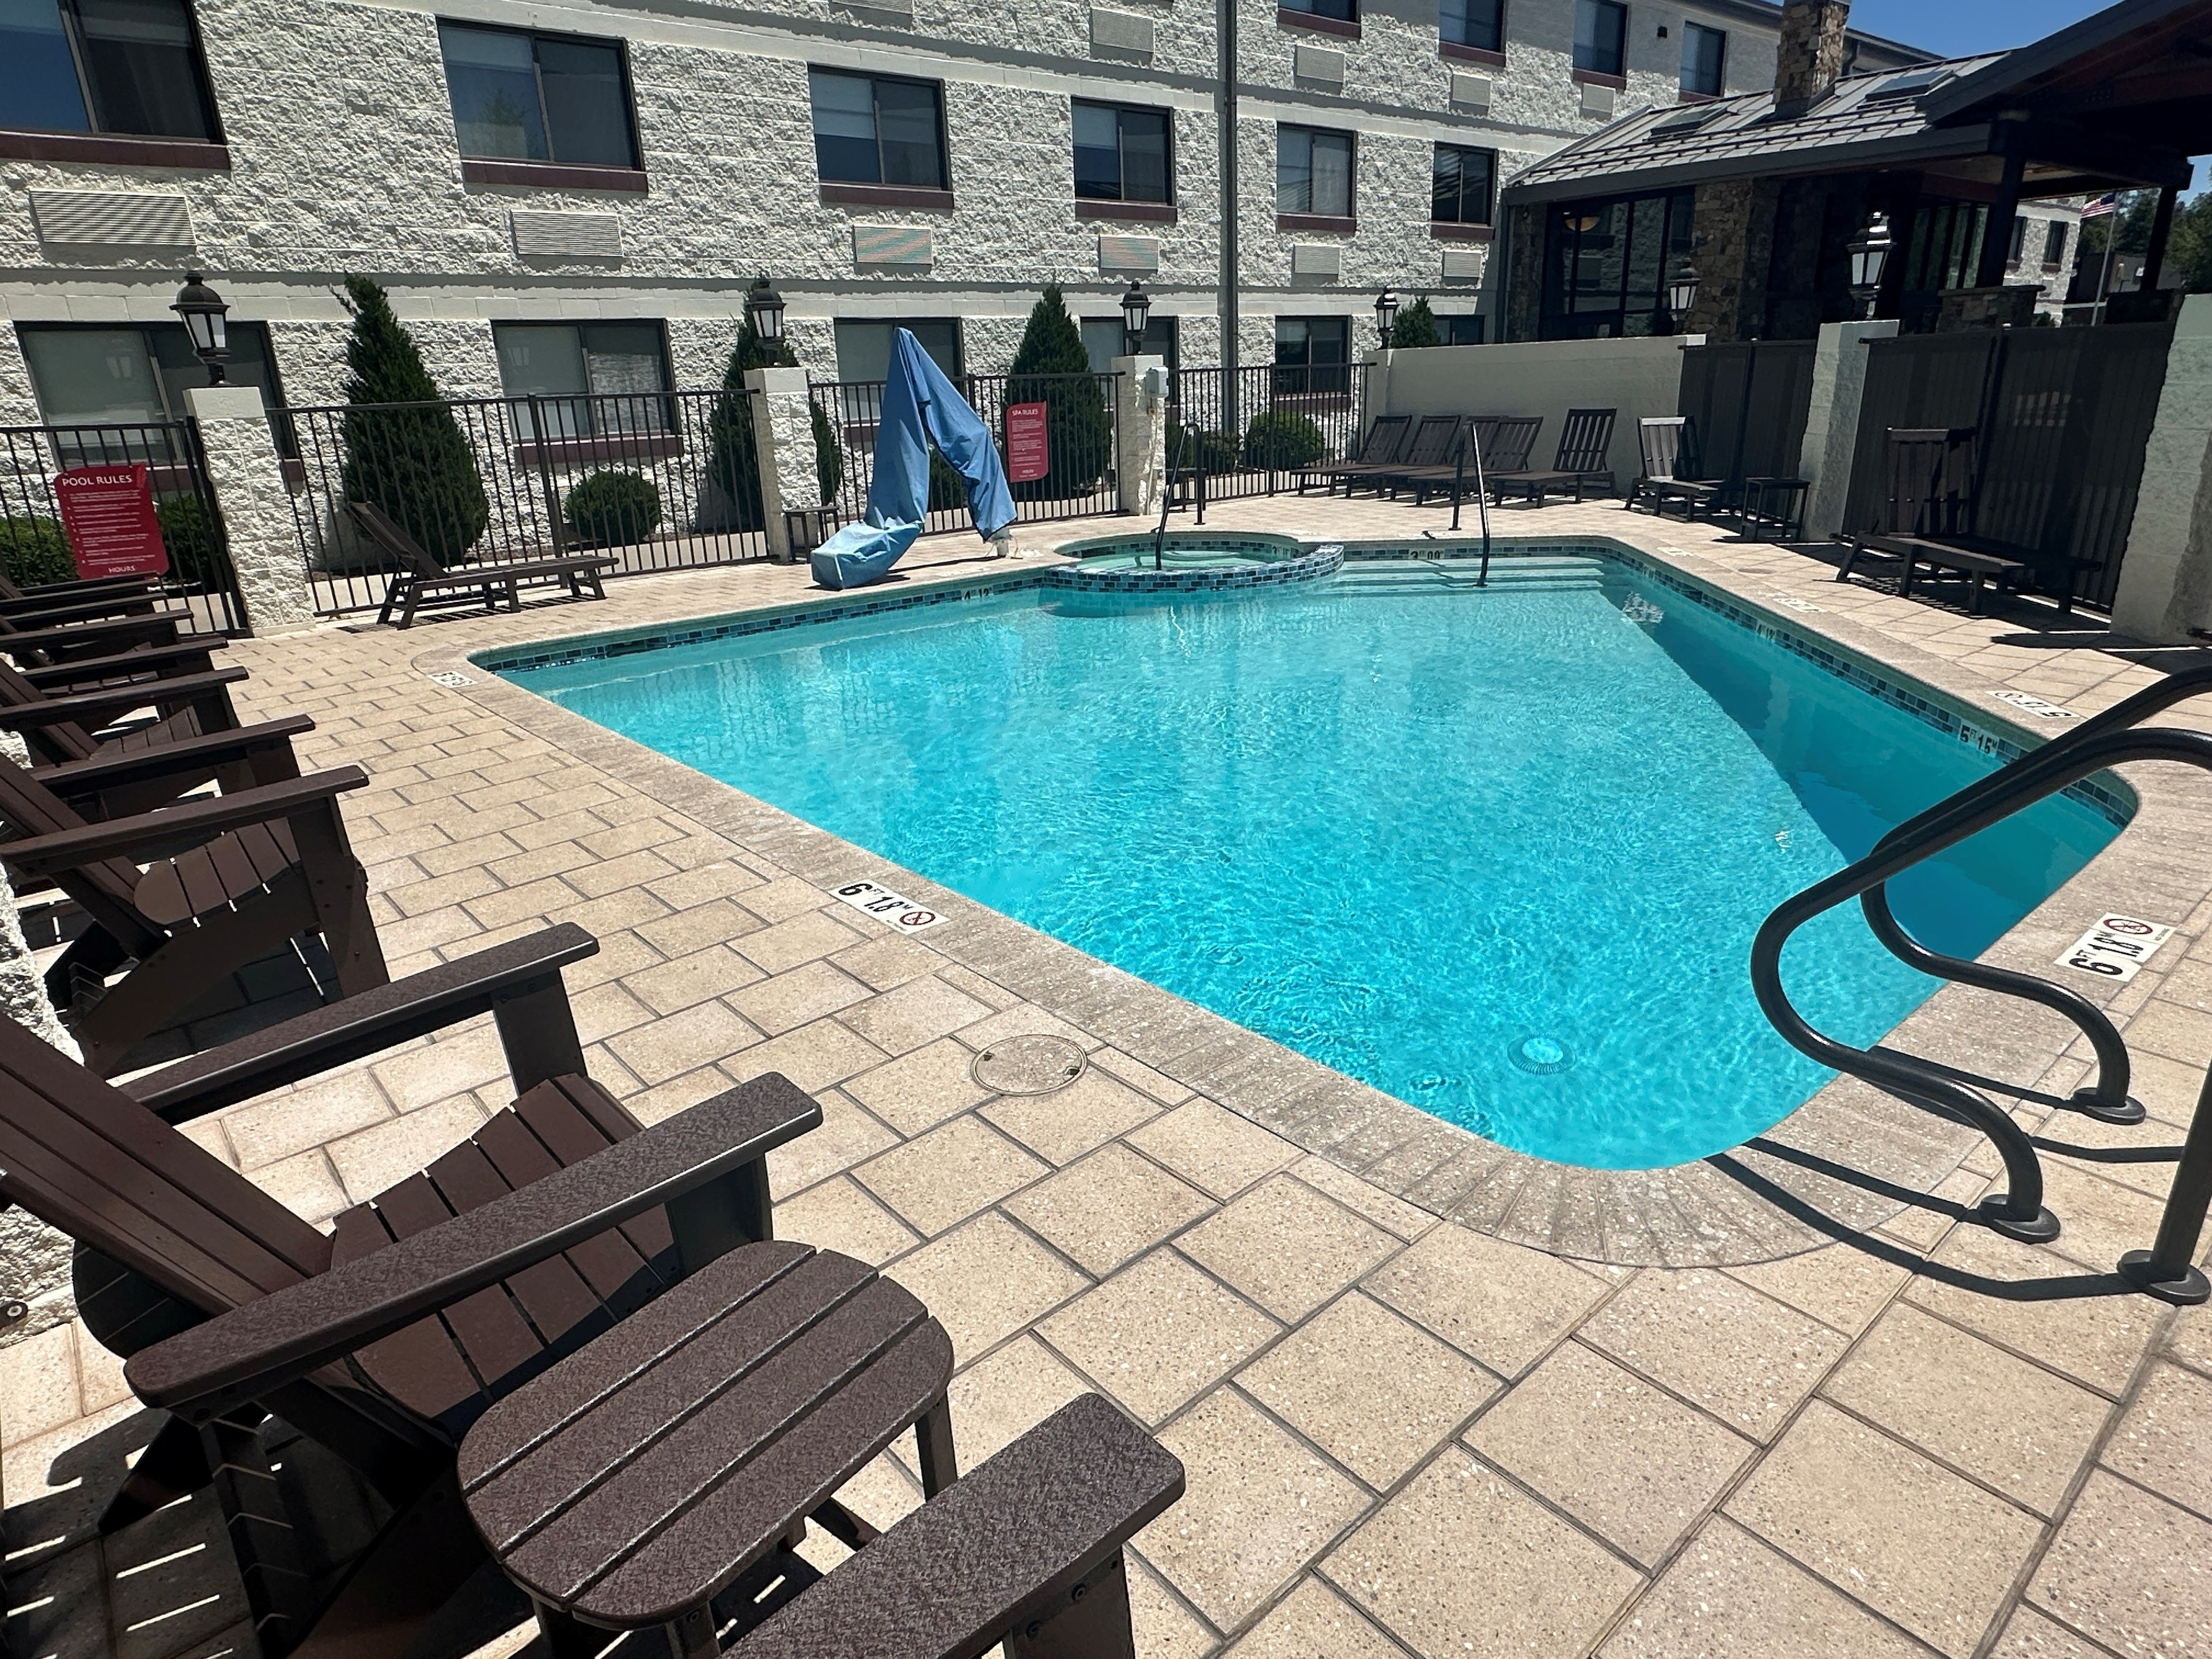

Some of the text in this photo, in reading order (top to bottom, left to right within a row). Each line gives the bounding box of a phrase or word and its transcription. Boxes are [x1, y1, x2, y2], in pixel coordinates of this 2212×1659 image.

[62, 475, 133, 486] POOL RULES
[108, 565, 136, 573] HOURS
[1960, 724, 1970, 743] 5
[1970, 729, 1977, 739] FT
[839, 883, 873, 896] 6
[863, 896, 905, 912] 1.8
[2087, 937, 2144, 957] 1.8
[2069, 957, 2123, 975] 6
